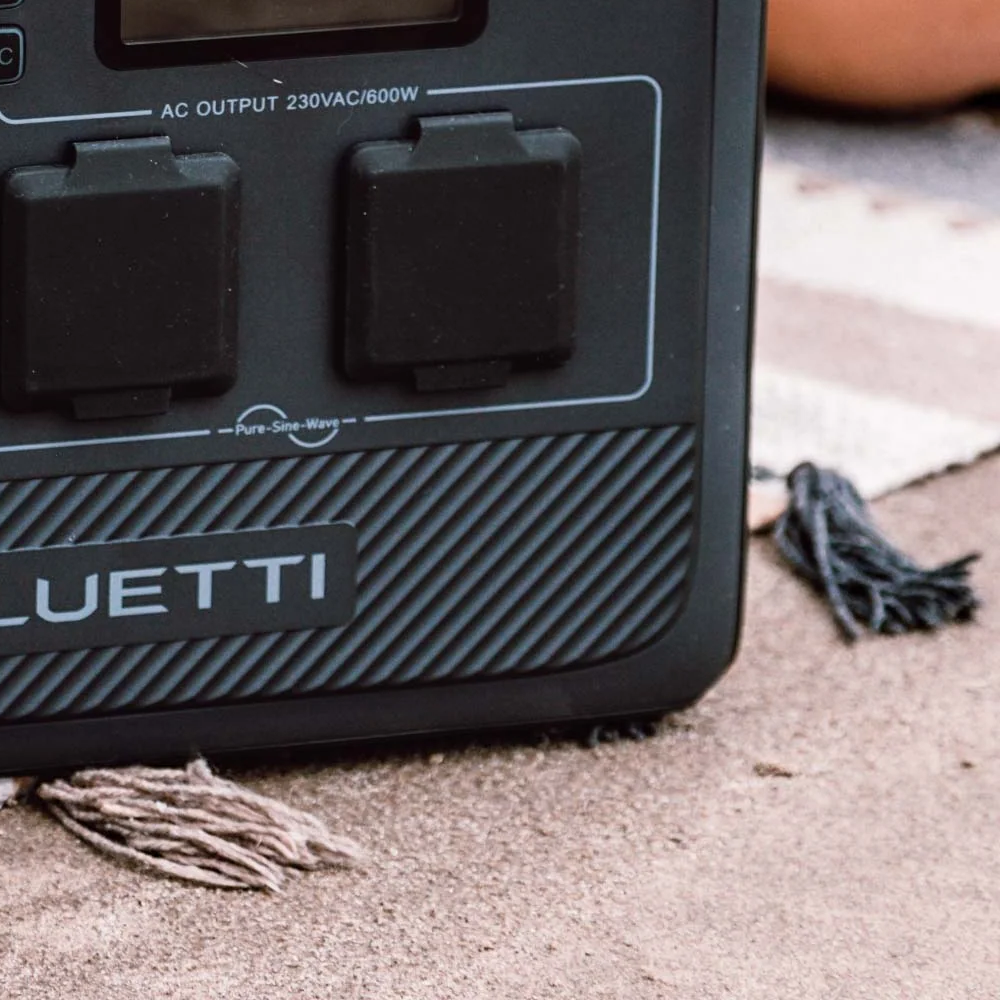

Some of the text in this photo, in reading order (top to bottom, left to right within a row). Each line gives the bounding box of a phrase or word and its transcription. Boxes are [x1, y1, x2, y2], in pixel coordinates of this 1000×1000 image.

[161, 86, 419, 119] AC OUTPUT 230VAC/600W
